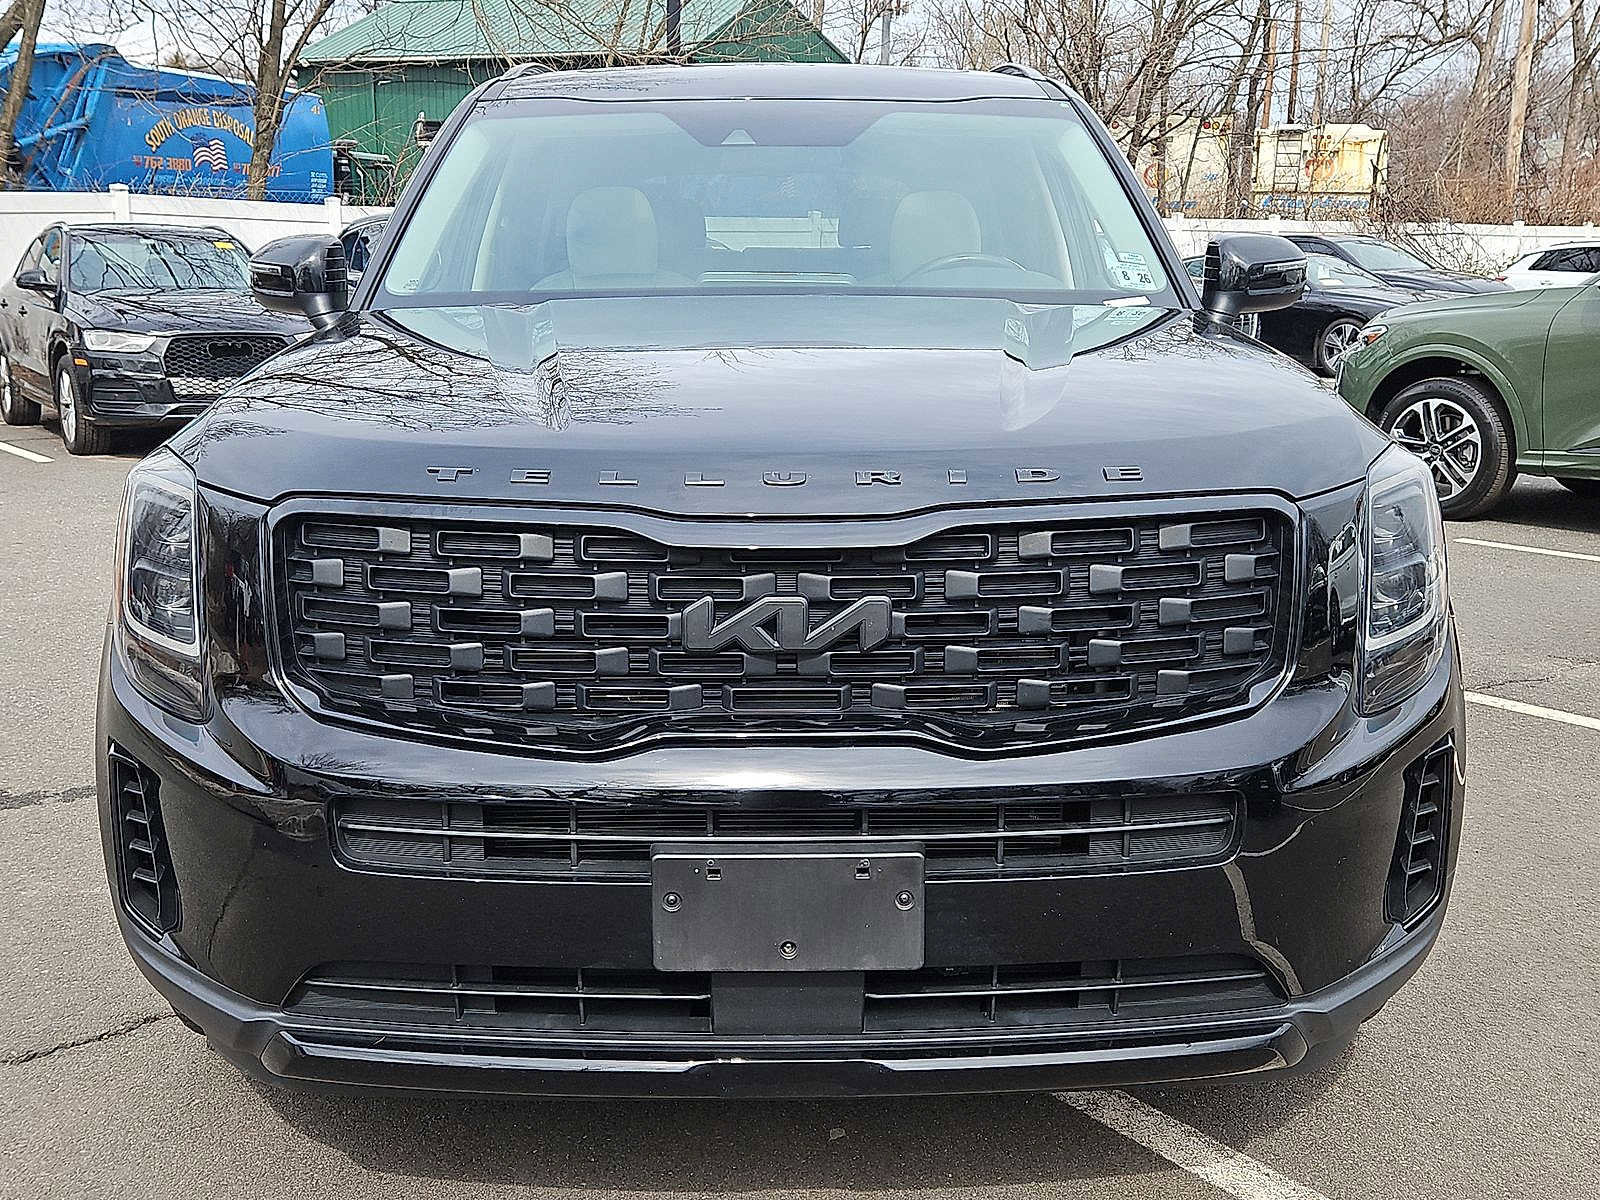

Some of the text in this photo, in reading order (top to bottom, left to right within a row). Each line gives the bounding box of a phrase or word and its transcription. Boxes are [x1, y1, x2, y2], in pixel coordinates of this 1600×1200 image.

[145, 107, 254, 152] SOUTH ORANGE DISPOSAL
[1121, 270, 1152, 284] 8 26
[427, 464, 1146, 488] TELLURIDE
[681, 595, 893, 654] KIA
